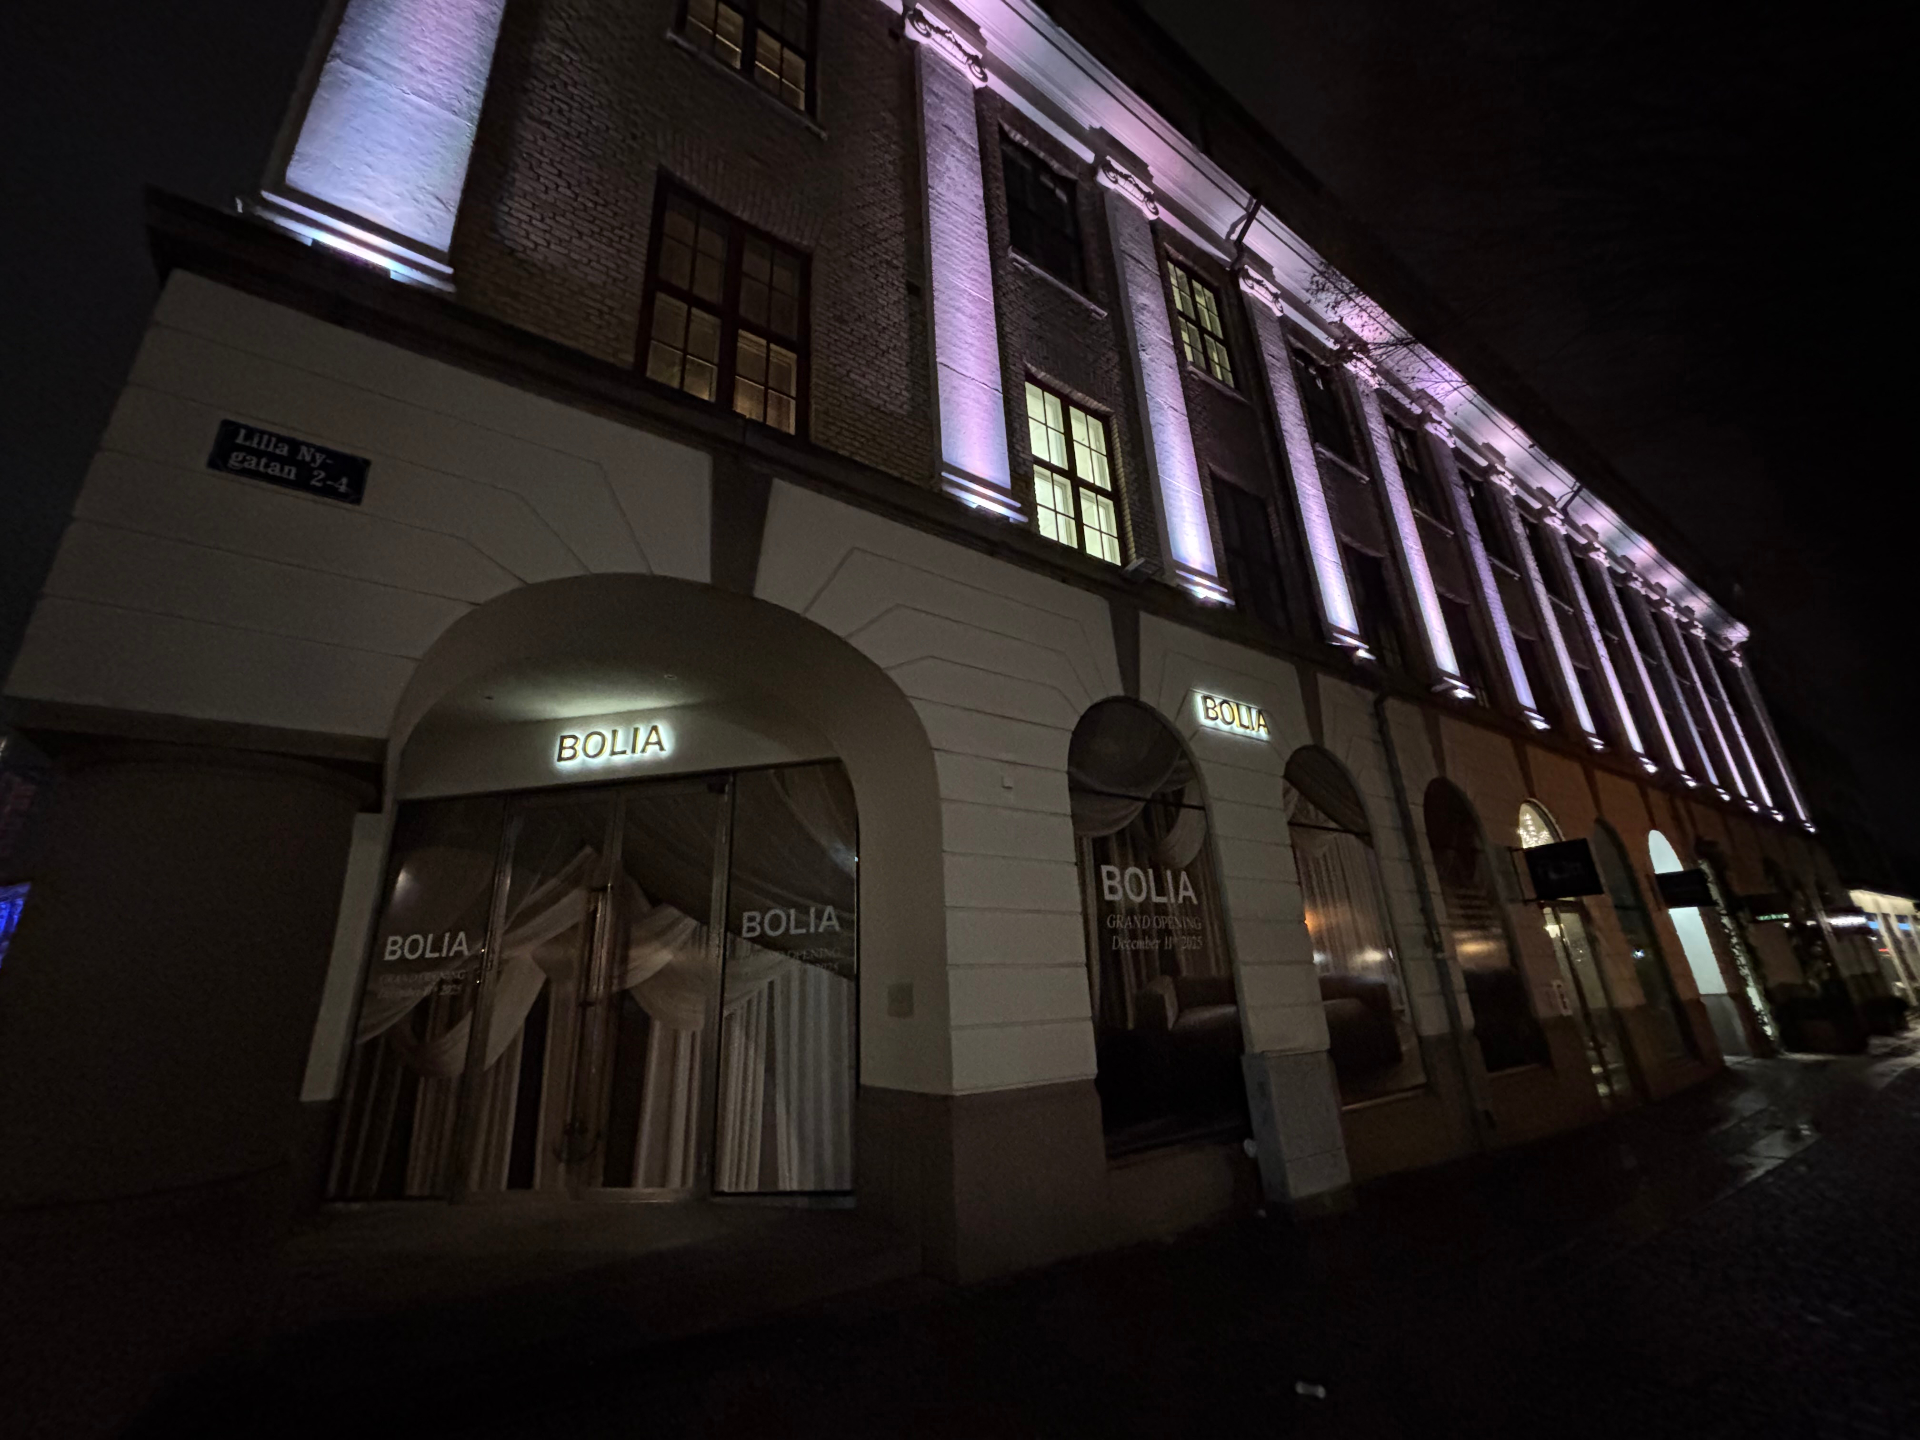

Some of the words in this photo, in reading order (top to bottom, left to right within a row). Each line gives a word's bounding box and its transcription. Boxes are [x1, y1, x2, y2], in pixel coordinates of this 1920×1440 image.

[235, 428, 289, 456] Lilla
[296, 446, 334, 467] Ny-
[227, 451, 297, 480] gatan
[310, 469, 349, 492] 2-4
[1201, 694, 1271, 735] BOLIA
[557, 724, 666, 762] BOLIA
[1100, 864, 1198, 905] BOLIA
[742, 905, 841, 938] BOLIA
[1106, 914, 1150, 929] GRAND
[1152, 915, 1202, 930] OPENING
[383, 931, 470, 961] BOLIA
